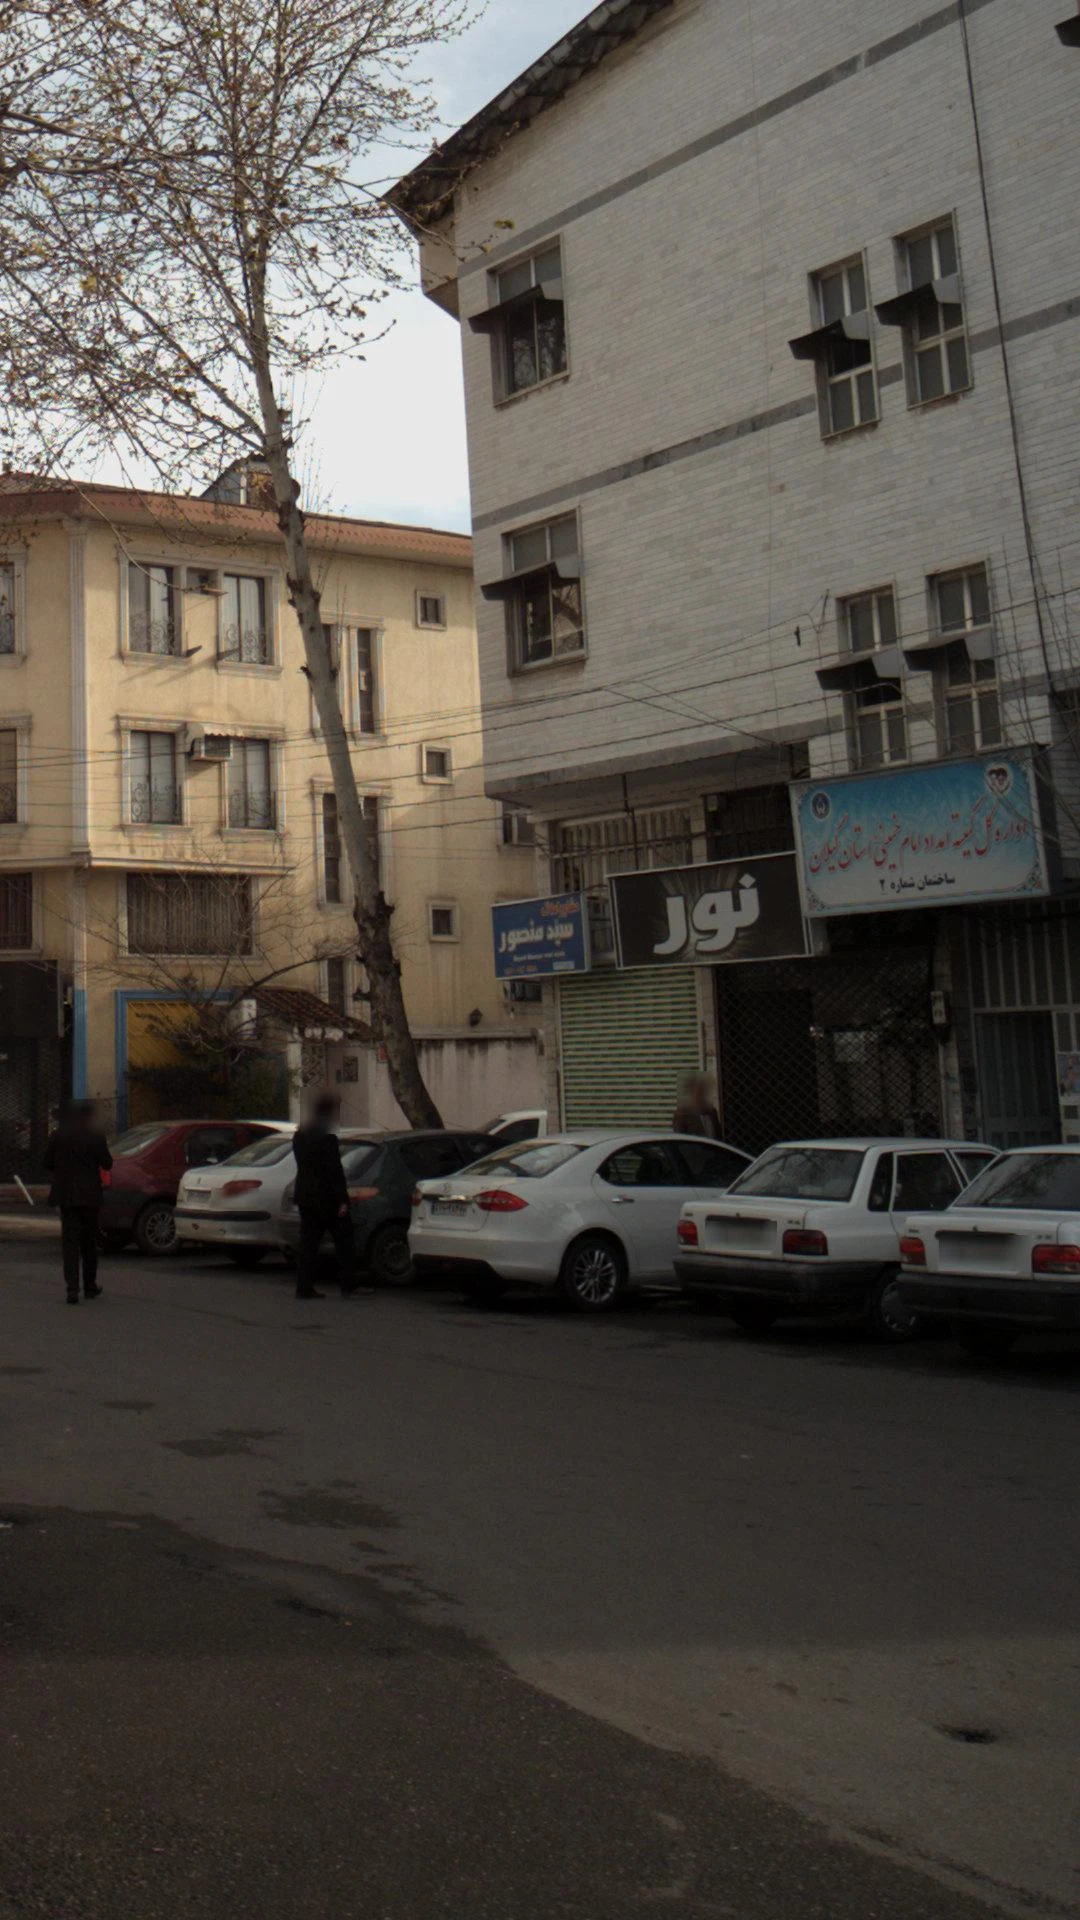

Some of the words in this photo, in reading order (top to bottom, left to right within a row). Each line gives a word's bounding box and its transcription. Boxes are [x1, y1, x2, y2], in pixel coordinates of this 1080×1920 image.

[808, 813, 849, 874] گیلان
[873, 814, 901, 870] خمینی
[924, 831, 950, 853] امداد
[952, 794, 988, 858] کمیته
[838, 826, 872, 870] استان
[900, 833, 920, 862] امام
[889, 877, 916, 894] شماره
[917, 873, 956, 892] ساختمان
[653, 872, 761, 956] نور
[498, 916, 544, 954] منصور
